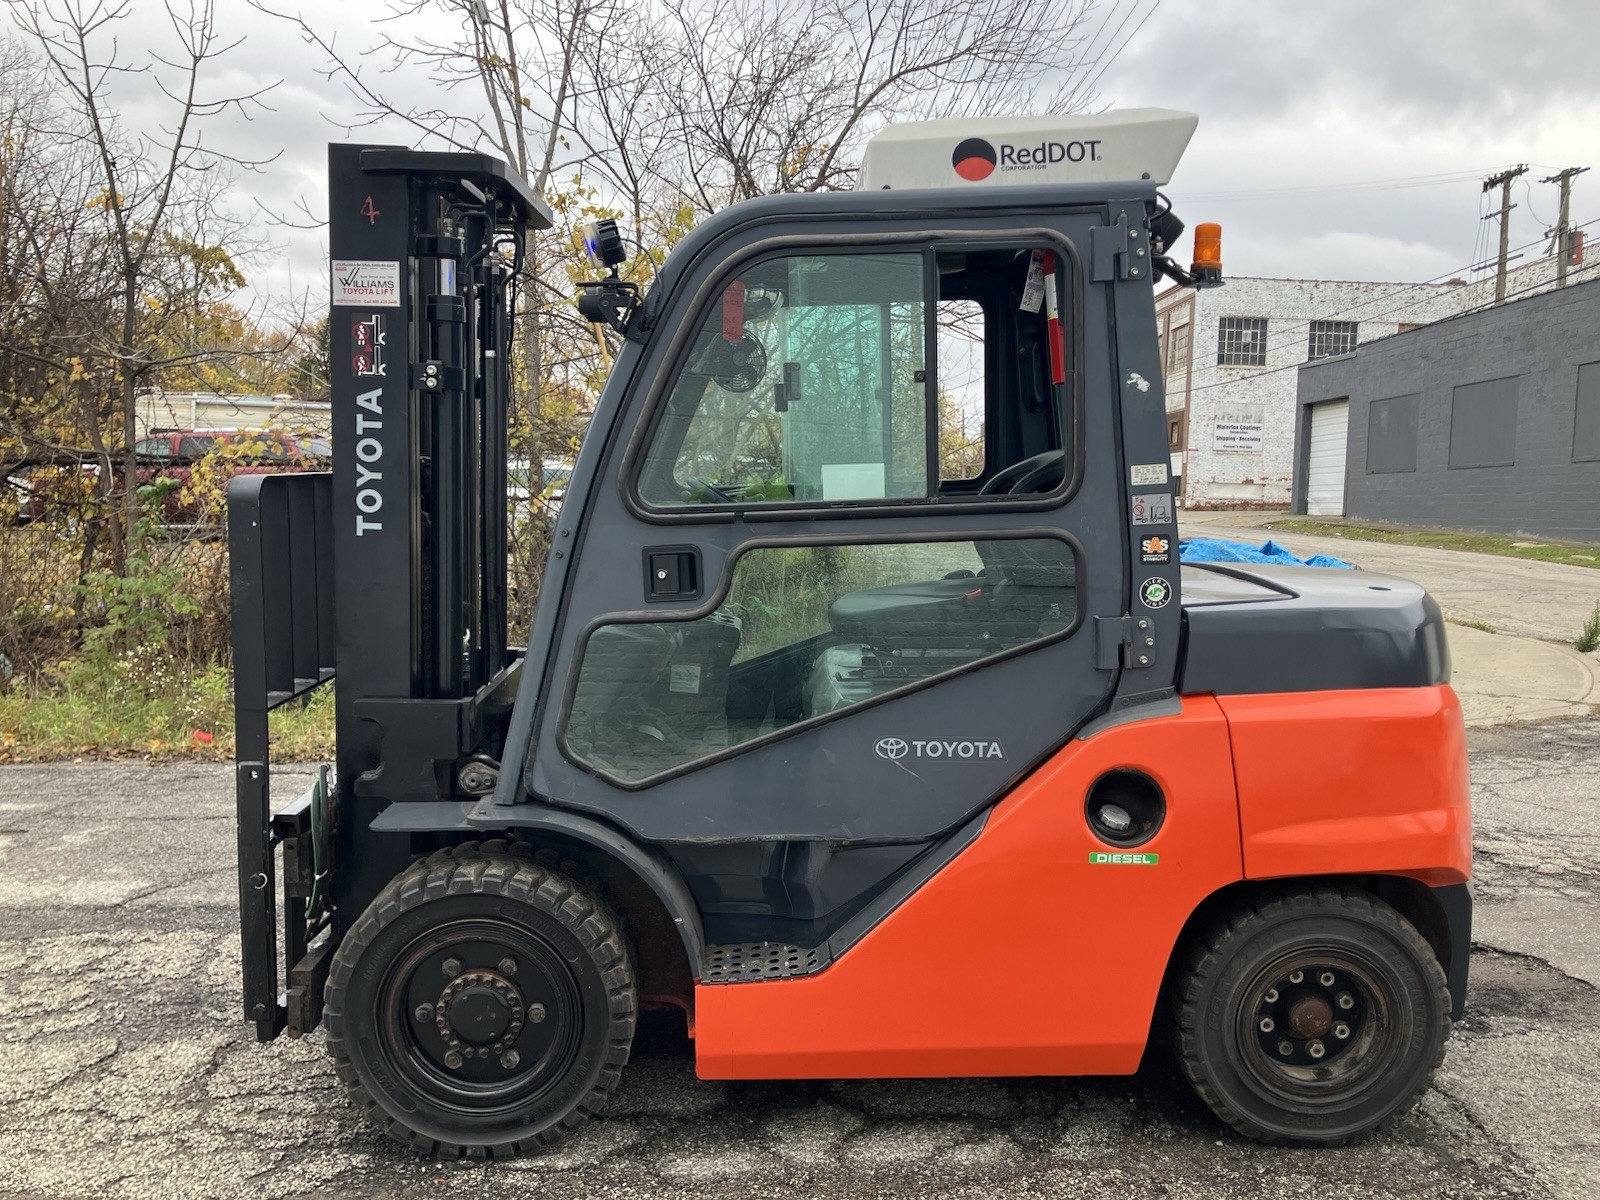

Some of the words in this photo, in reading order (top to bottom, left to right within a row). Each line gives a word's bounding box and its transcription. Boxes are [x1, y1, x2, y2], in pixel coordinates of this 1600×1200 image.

[1001, 164, 1047, 172] CORPORATION
[360, 196, 380, 225] 4
[338, 267, 395, 289] WILLIAMS
[342, 287, 375, 295] TOYOTA
[355, 387, 383, 536] TOYOTA
[1142, 536, 1169, 553] SAS
[912, 740, 1003, 758] TOYOTA
[1097, 853, 1151, 864] DIESEL
